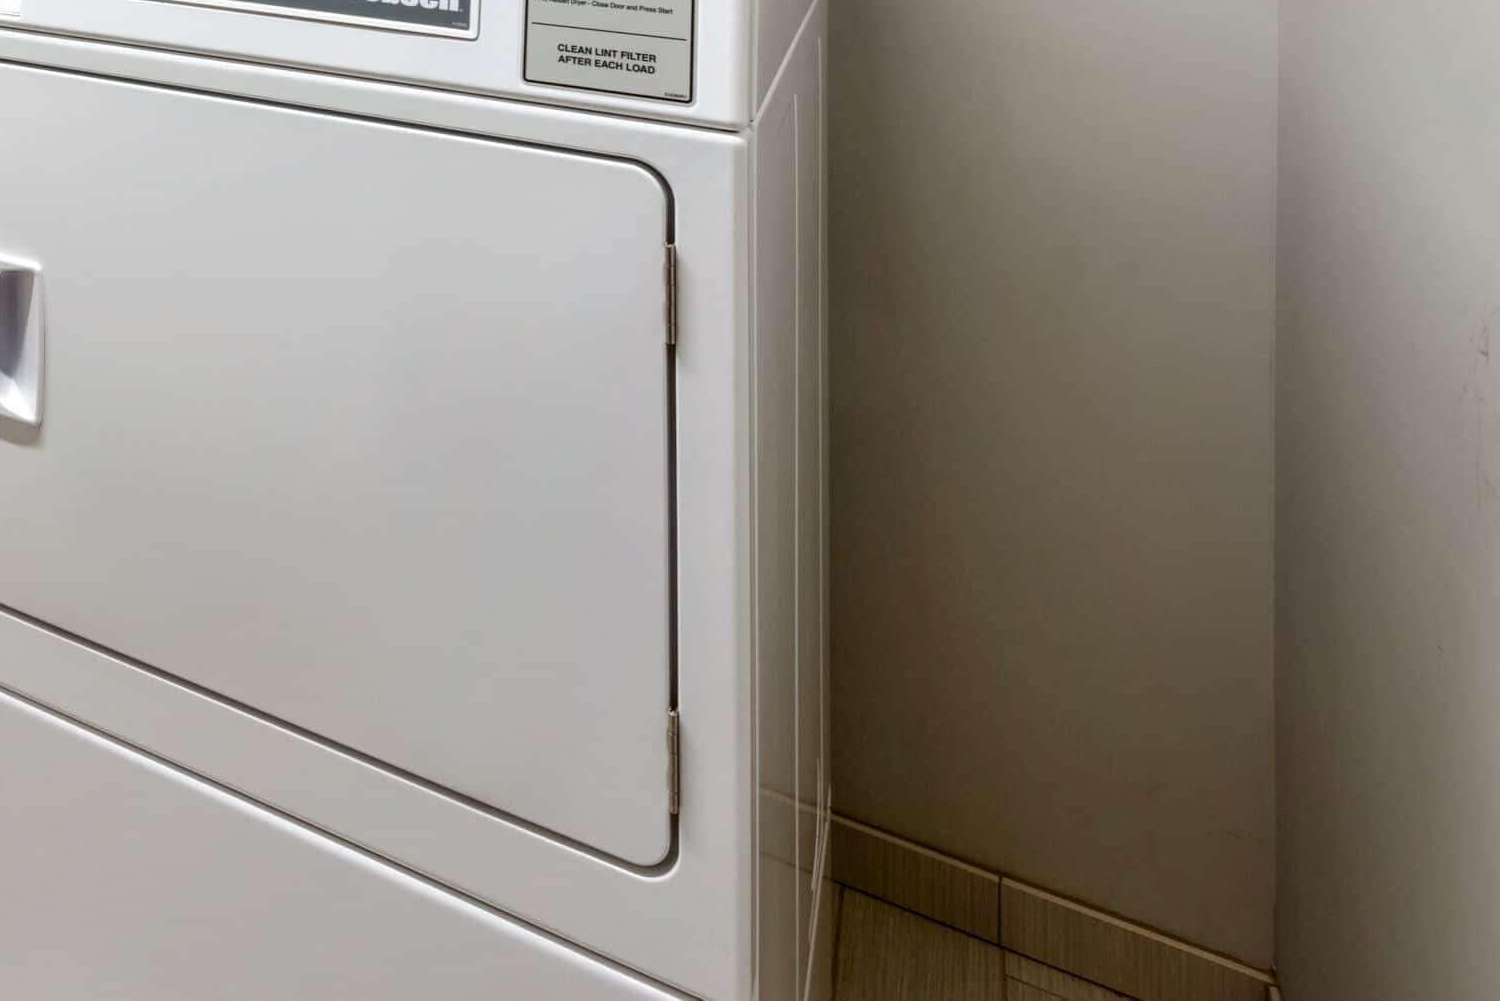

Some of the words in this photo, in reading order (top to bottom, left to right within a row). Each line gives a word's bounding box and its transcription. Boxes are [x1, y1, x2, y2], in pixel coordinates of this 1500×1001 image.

[591, 0, 608, 8] Close
[610, 2, 625, 10] Door
[557, 43, 592, 55] CLEAN
[595, 48, 618, 59] LINT
[620, 51, 657, 63] FILTER
[558, 55, 592, 67] AFTER
[594, 60, 623, 70] EACH
[626, 63, 655, 75] LOAD
